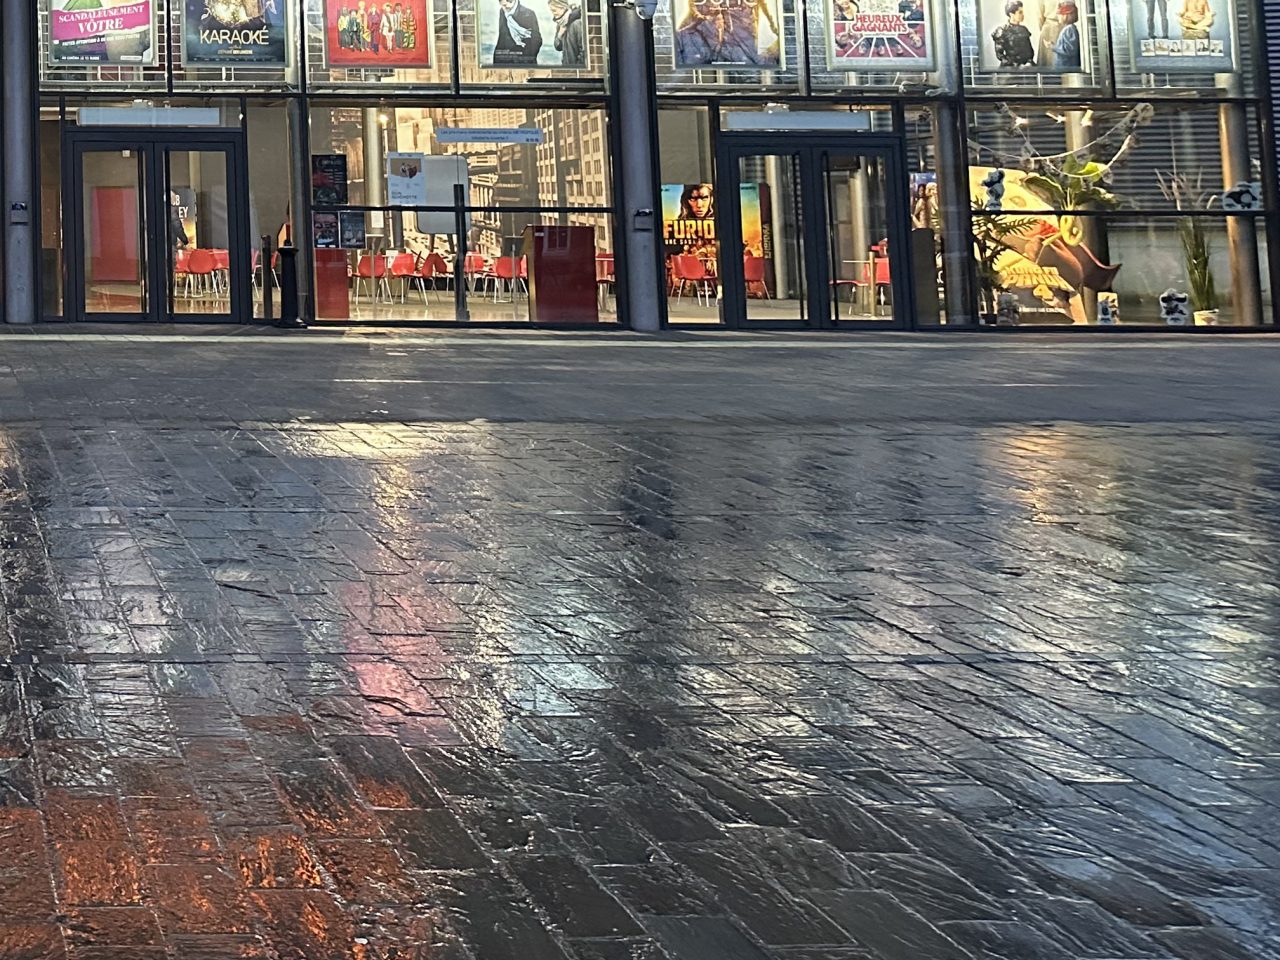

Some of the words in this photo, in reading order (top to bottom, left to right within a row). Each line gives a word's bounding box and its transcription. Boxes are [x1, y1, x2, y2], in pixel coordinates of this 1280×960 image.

[58, 5, 145, 23] SCANDALEUSEMENT
[855, 14, 902, 23] HEUREUX
[78, 18, 124, 34] VÔTRE
[199, 25, 270, 45] KARAOKÉ
[851, 23, 908, 32] GAGNANTS
[1001, 274, 1075, 292] PANDA
[1032, 284, 1054, 302] 4
